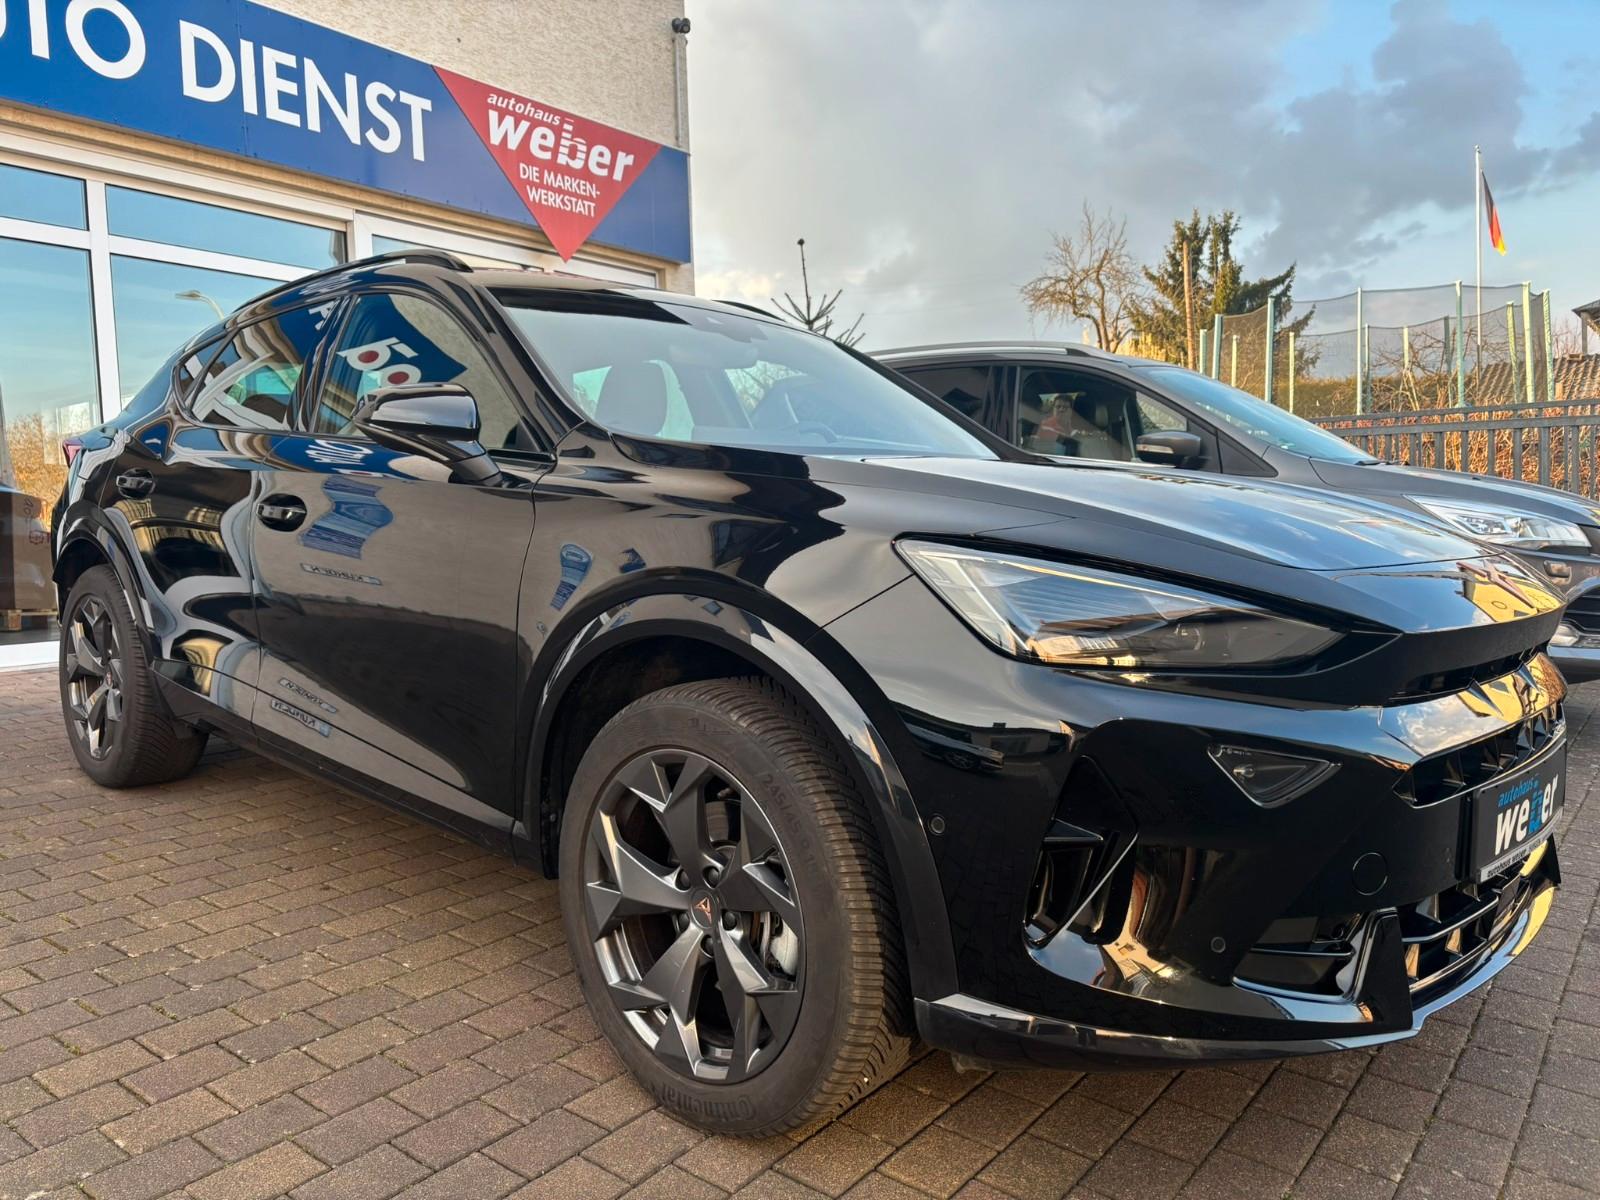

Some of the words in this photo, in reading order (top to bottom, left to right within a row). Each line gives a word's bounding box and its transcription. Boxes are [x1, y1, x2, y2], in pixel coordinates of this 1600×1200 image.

[178, 19, 432, 162] DIENST
[487, 93, 561, 126] autohaus
[488, 109, 635, 182] weber
[519, 162, 540, 183] DIE
[543, 169, 601, 198] MARKEN-
[526, 184, 596, 218] WERKSTATT
[1498, 777, 1533, 808] autohaus
[1494, 773, 1559, 856] weber
